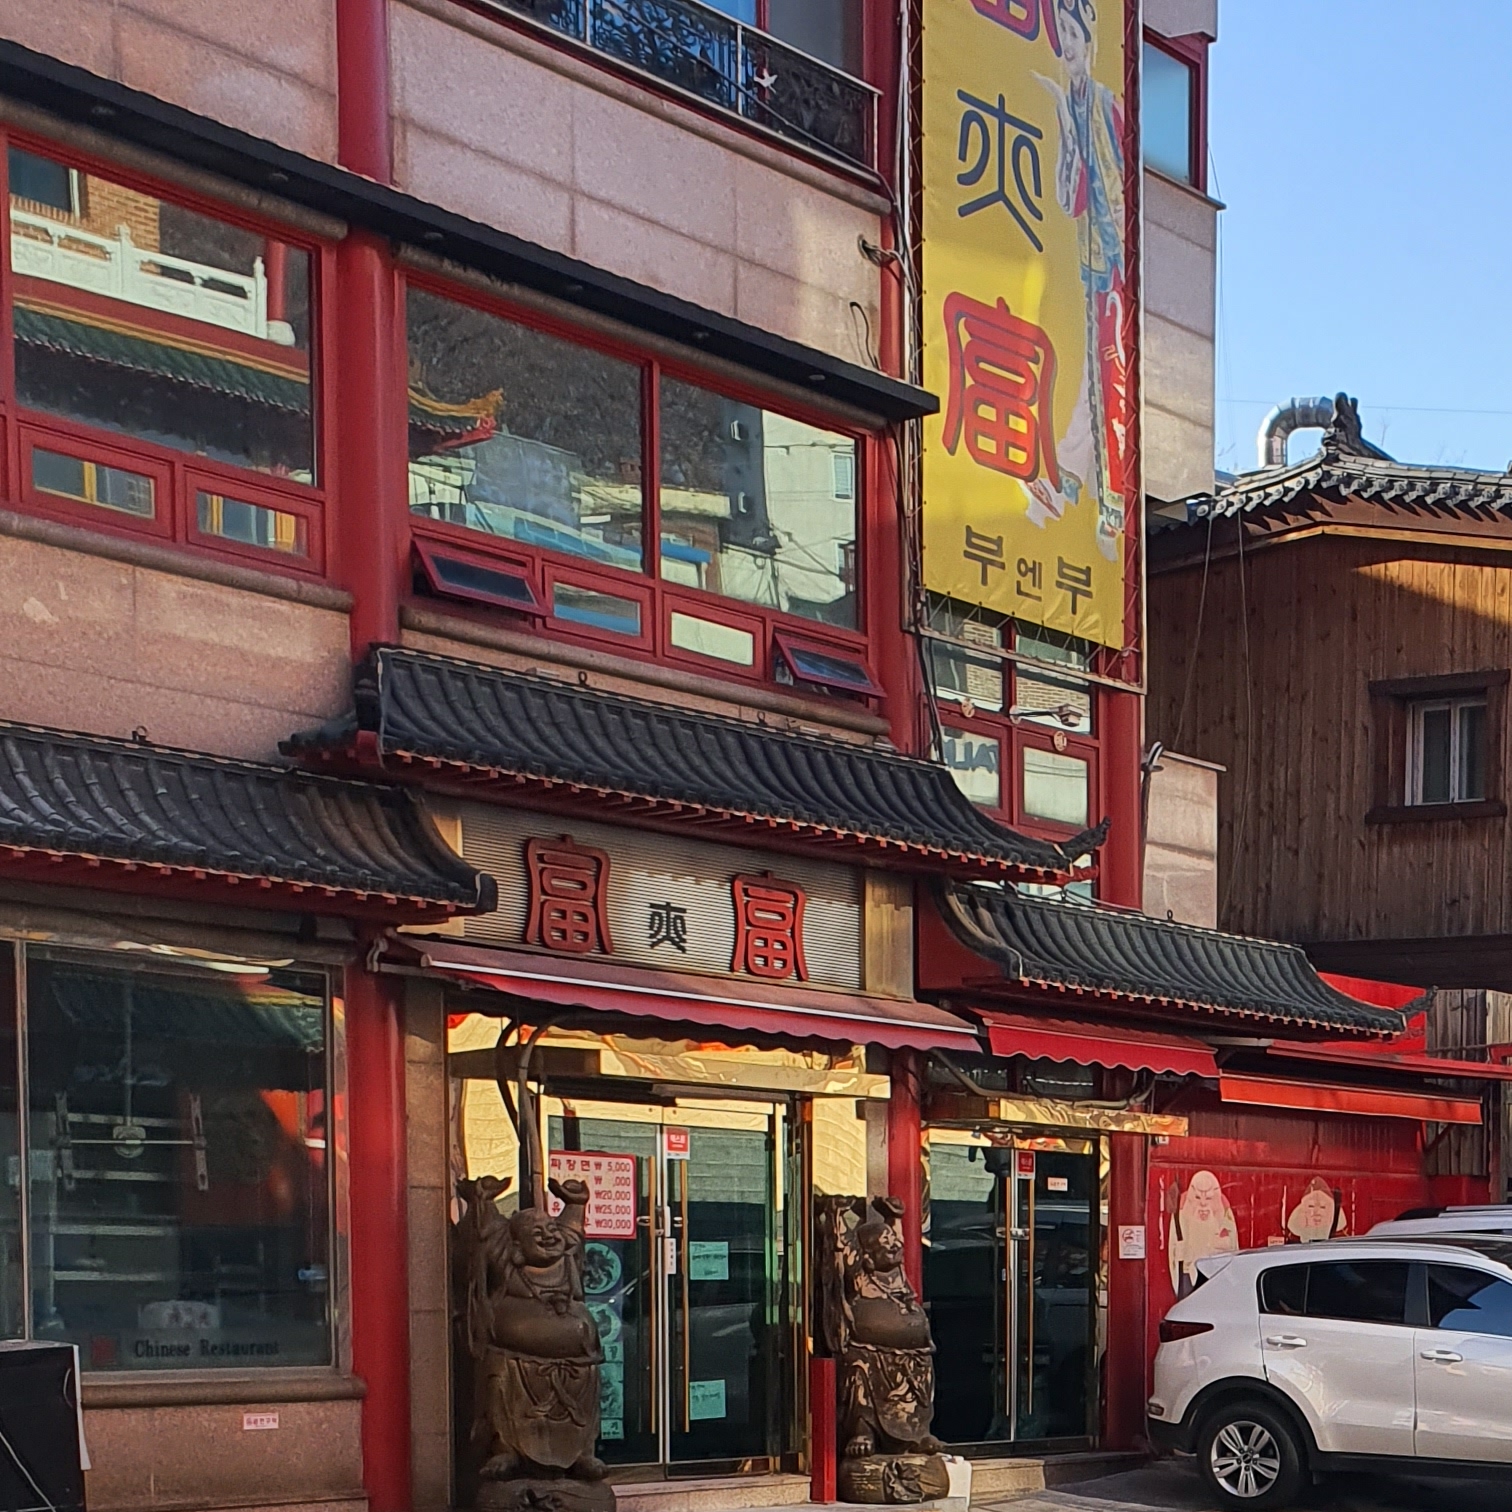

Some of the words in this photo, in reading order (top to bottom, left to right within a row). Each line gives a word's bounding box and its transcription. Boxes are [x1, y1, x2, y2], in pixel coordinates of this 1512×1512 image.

[963, 525, 1093, 615] 부엔부
[134, 1339, 190, 1358] Chinese
[200, 1338, 280, 1356] Restaurant
